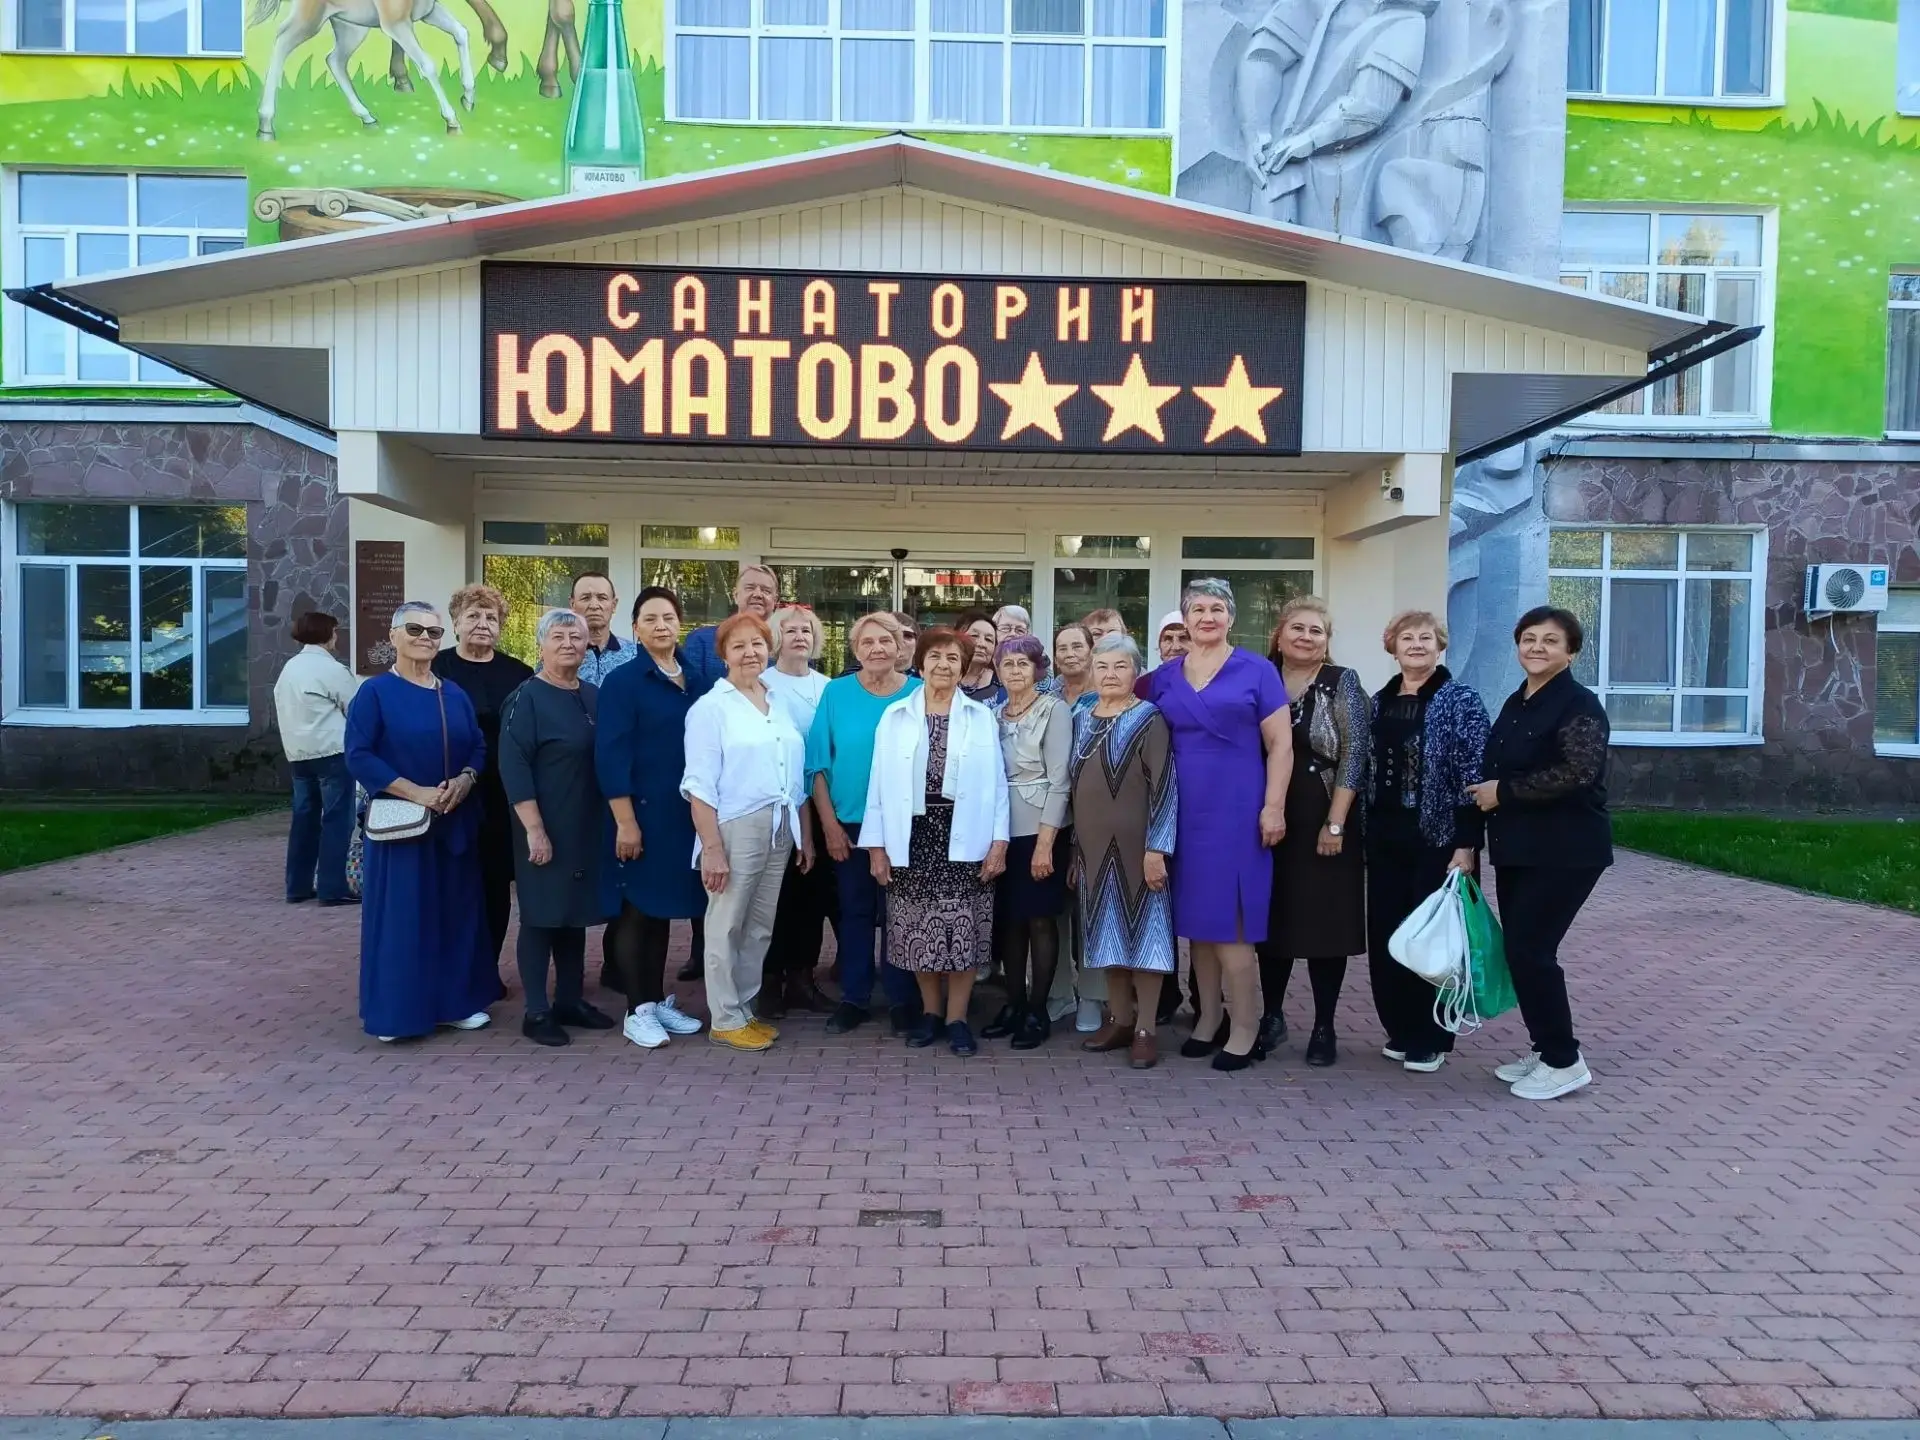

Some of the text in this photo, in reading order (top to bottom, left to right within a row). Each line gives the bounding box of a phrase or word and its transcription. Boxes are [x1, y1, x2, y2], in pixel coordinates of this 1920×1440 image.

[584, 172, 626, 183] ЮМАТОВО
[606, 272, 1155, 343] САНАТОРИЙ
[496, 332, 981, 443] ЮМАТОВО
